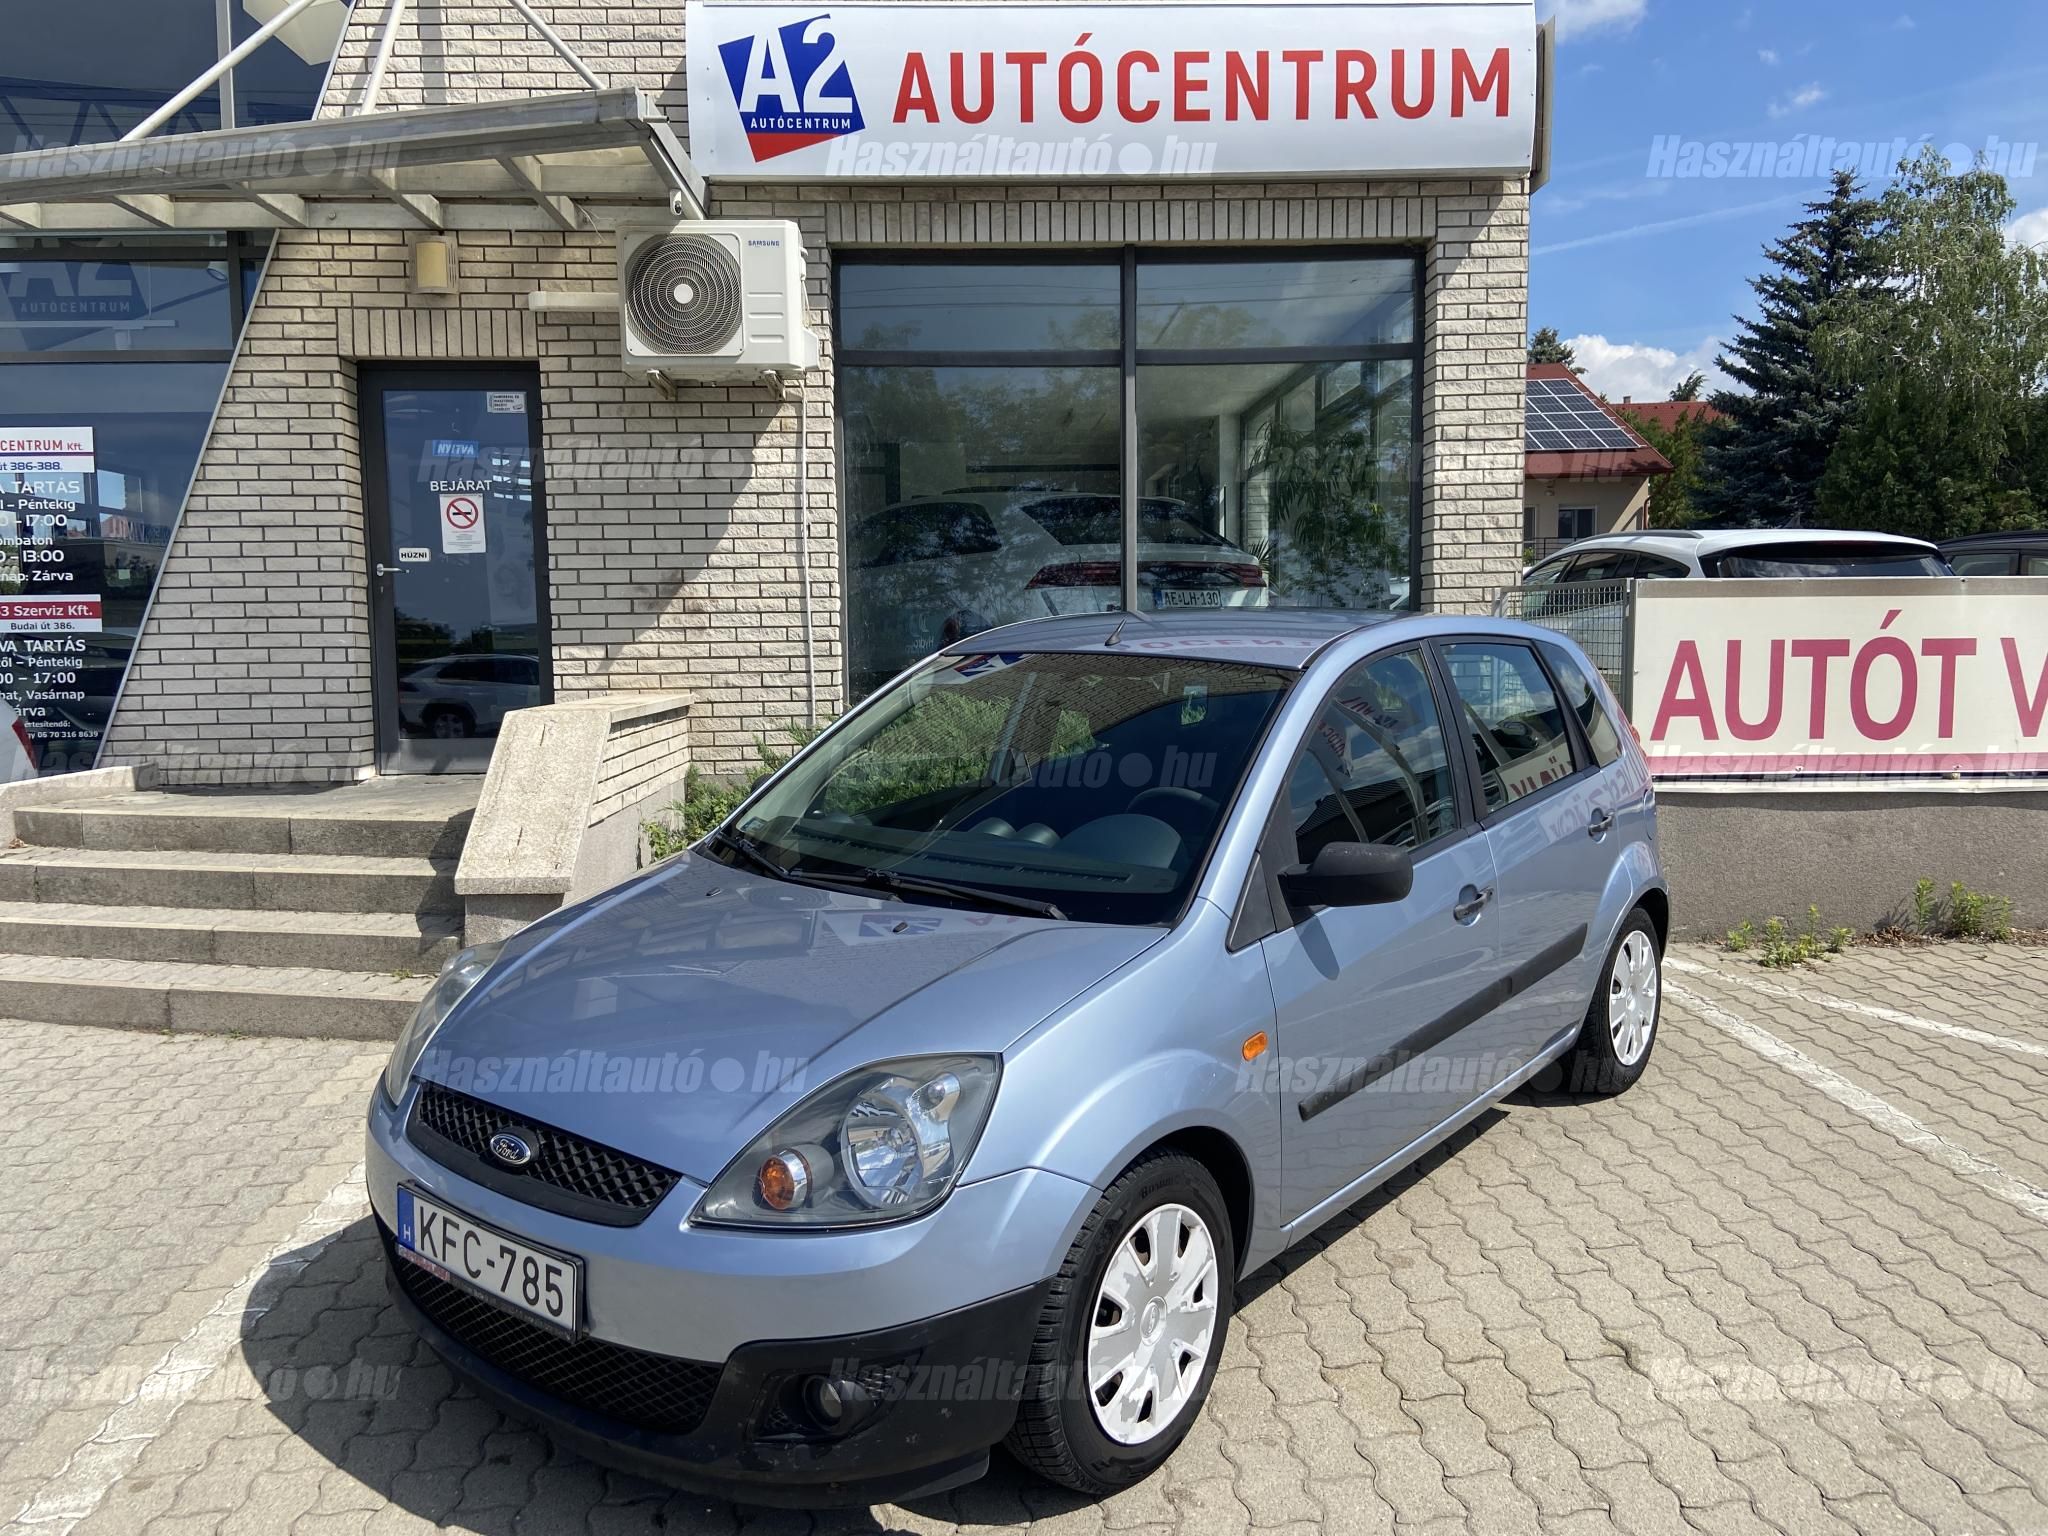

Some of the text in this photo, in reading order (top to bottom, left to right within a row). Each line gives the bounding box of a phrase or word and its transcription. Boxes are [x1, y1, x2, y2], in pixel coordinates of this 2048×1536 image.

[739, 18, 853, 113] A2
[892, 33, 1510, 124] AUTÓCENTRUM
[751, 116, 851, 130] AUTÓCENTRUM
[437, 443, 475, 455] NYITVA
[11, 477, 80, 494] TARTÁS
[429, 477, 493, 491] BEJÁRAT
[18, 499, 76, 512] Péntekig
[25, 514, 67, 527] 17:00
[23, 549, 65, 562] 13:00
[32, 570, 74, 581] Zárva
[13, 605, 65, 616] Szerviz
[68, 604, 93, 616] Kft.
[10, 622, 75, 630] Budai út 386.
[24, 635, 86, 652] TARTÁS
[28, 656, 83, 669] Péntekig
[33, 672, 76, 684] 17:00
[1650, 609, 1977, 741] AUTÓT
[26, 689, 85, 701] Vasárnap
[496, 1138, 519, 1160] Ford
[420, 1206, 564, 1317] KFC-785
